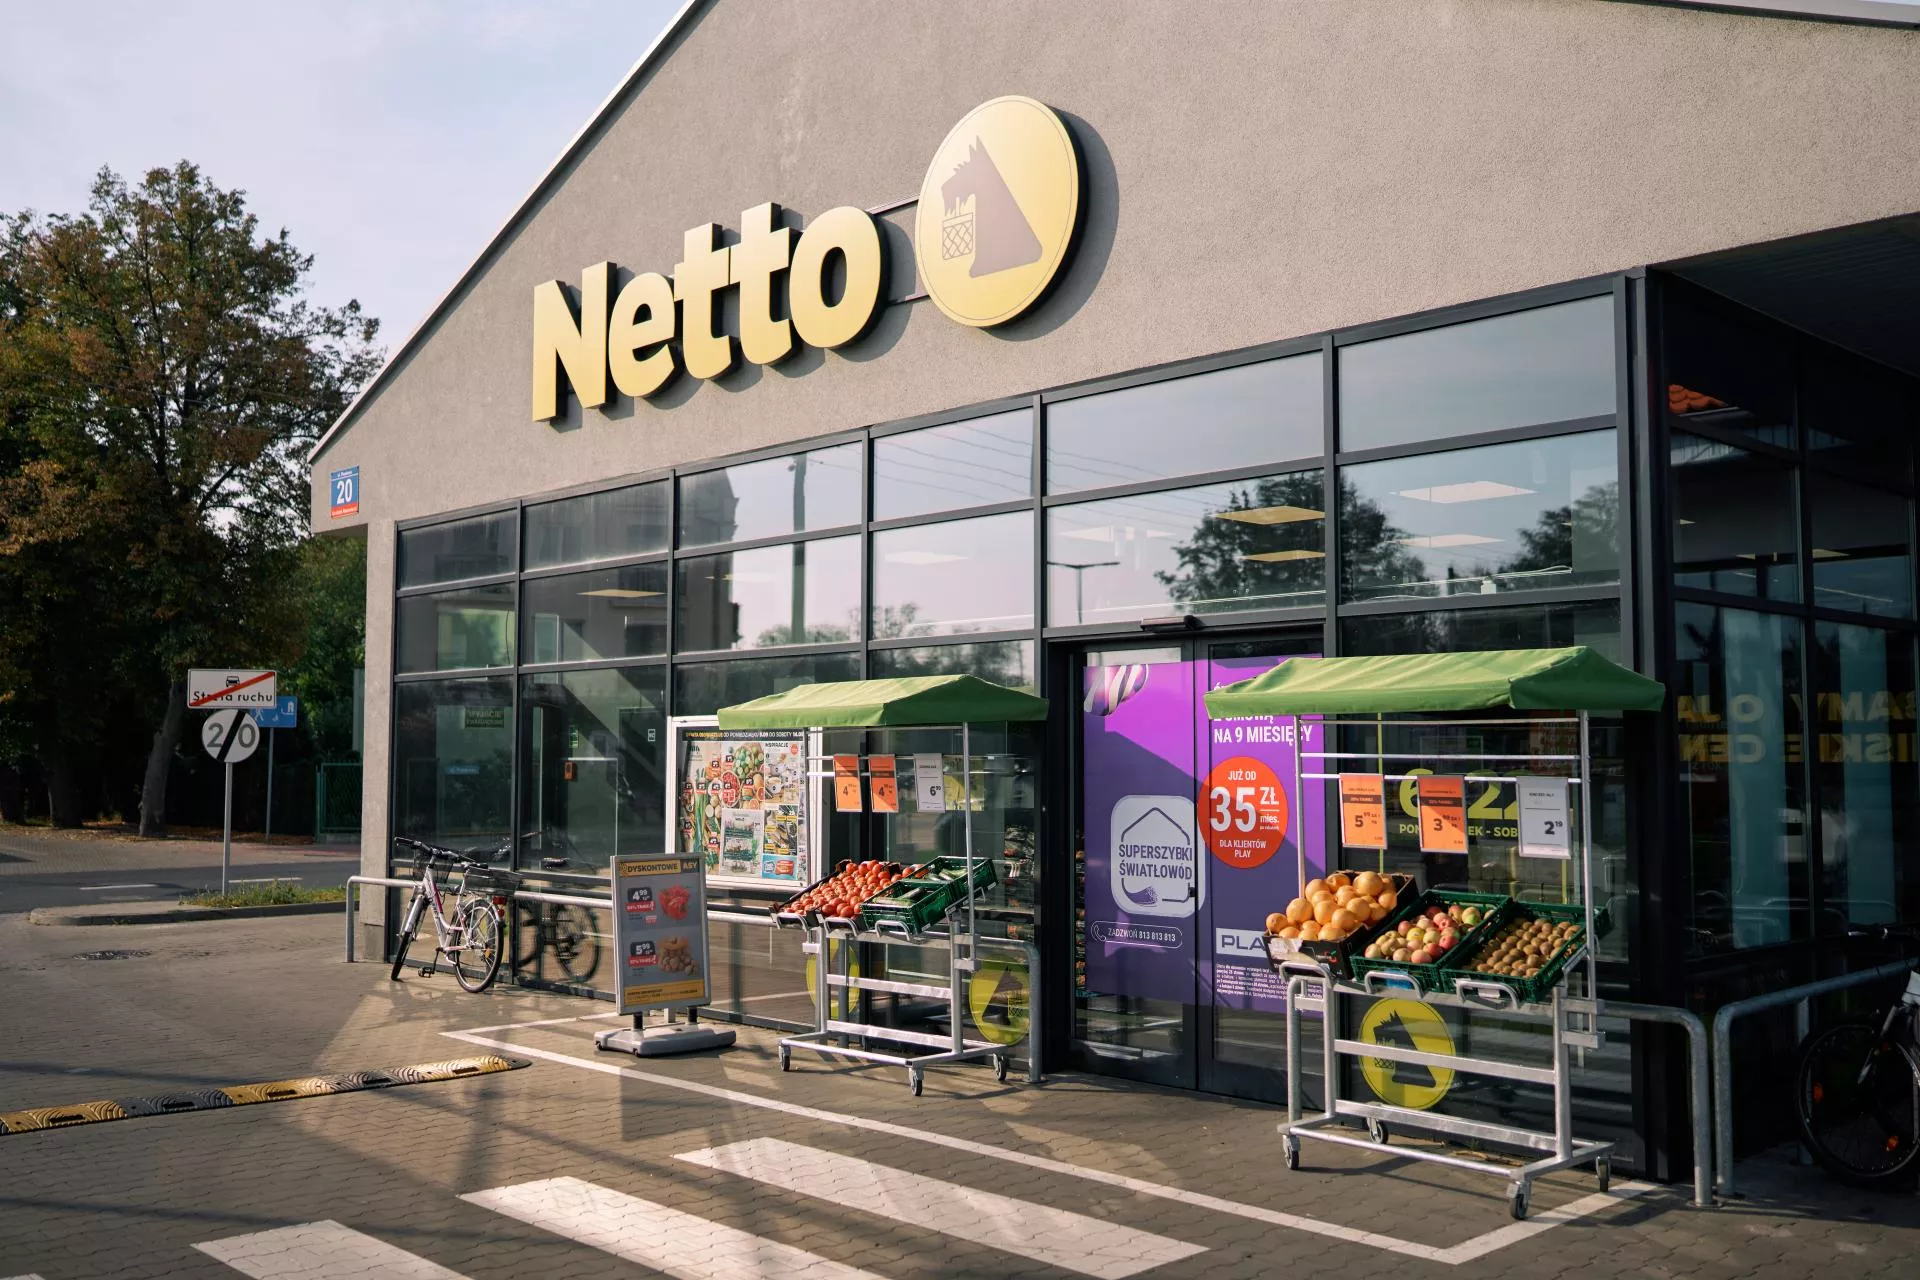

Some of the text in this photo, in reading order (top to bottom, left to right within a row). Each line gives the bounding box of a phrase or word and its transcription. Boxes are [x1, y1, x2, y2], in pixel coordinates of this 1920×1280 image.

[532, 201, 887, 422] Netto
[336, 478, 353, 505] 20
[237, 692, 273, 702] ruchu
[206, 721, 256, 748] 20
[1213, 728, 1233, 744] NA
[1234, 726, 1243, 743] 9
[1227, 768, 1257, 781] JUŻ OD
[1210, 786, 1280, 833] 35 ZŁ
[1260, 813, 1280, 823] mies.
[1219, 838, 1267, 849] DLA KLIENTÓW
[1118, 844, 1193, 861] SUPERSZYBKI
[1234, 849, 1251, 858] PLAY
[627, 861, 679, 873] DYSKONTOWE
[1119, 860, 1193, 880] ŚWIATŁOWÓD
[1107, 927, 1176, 942] ZADZWOŃ 813 813 813
